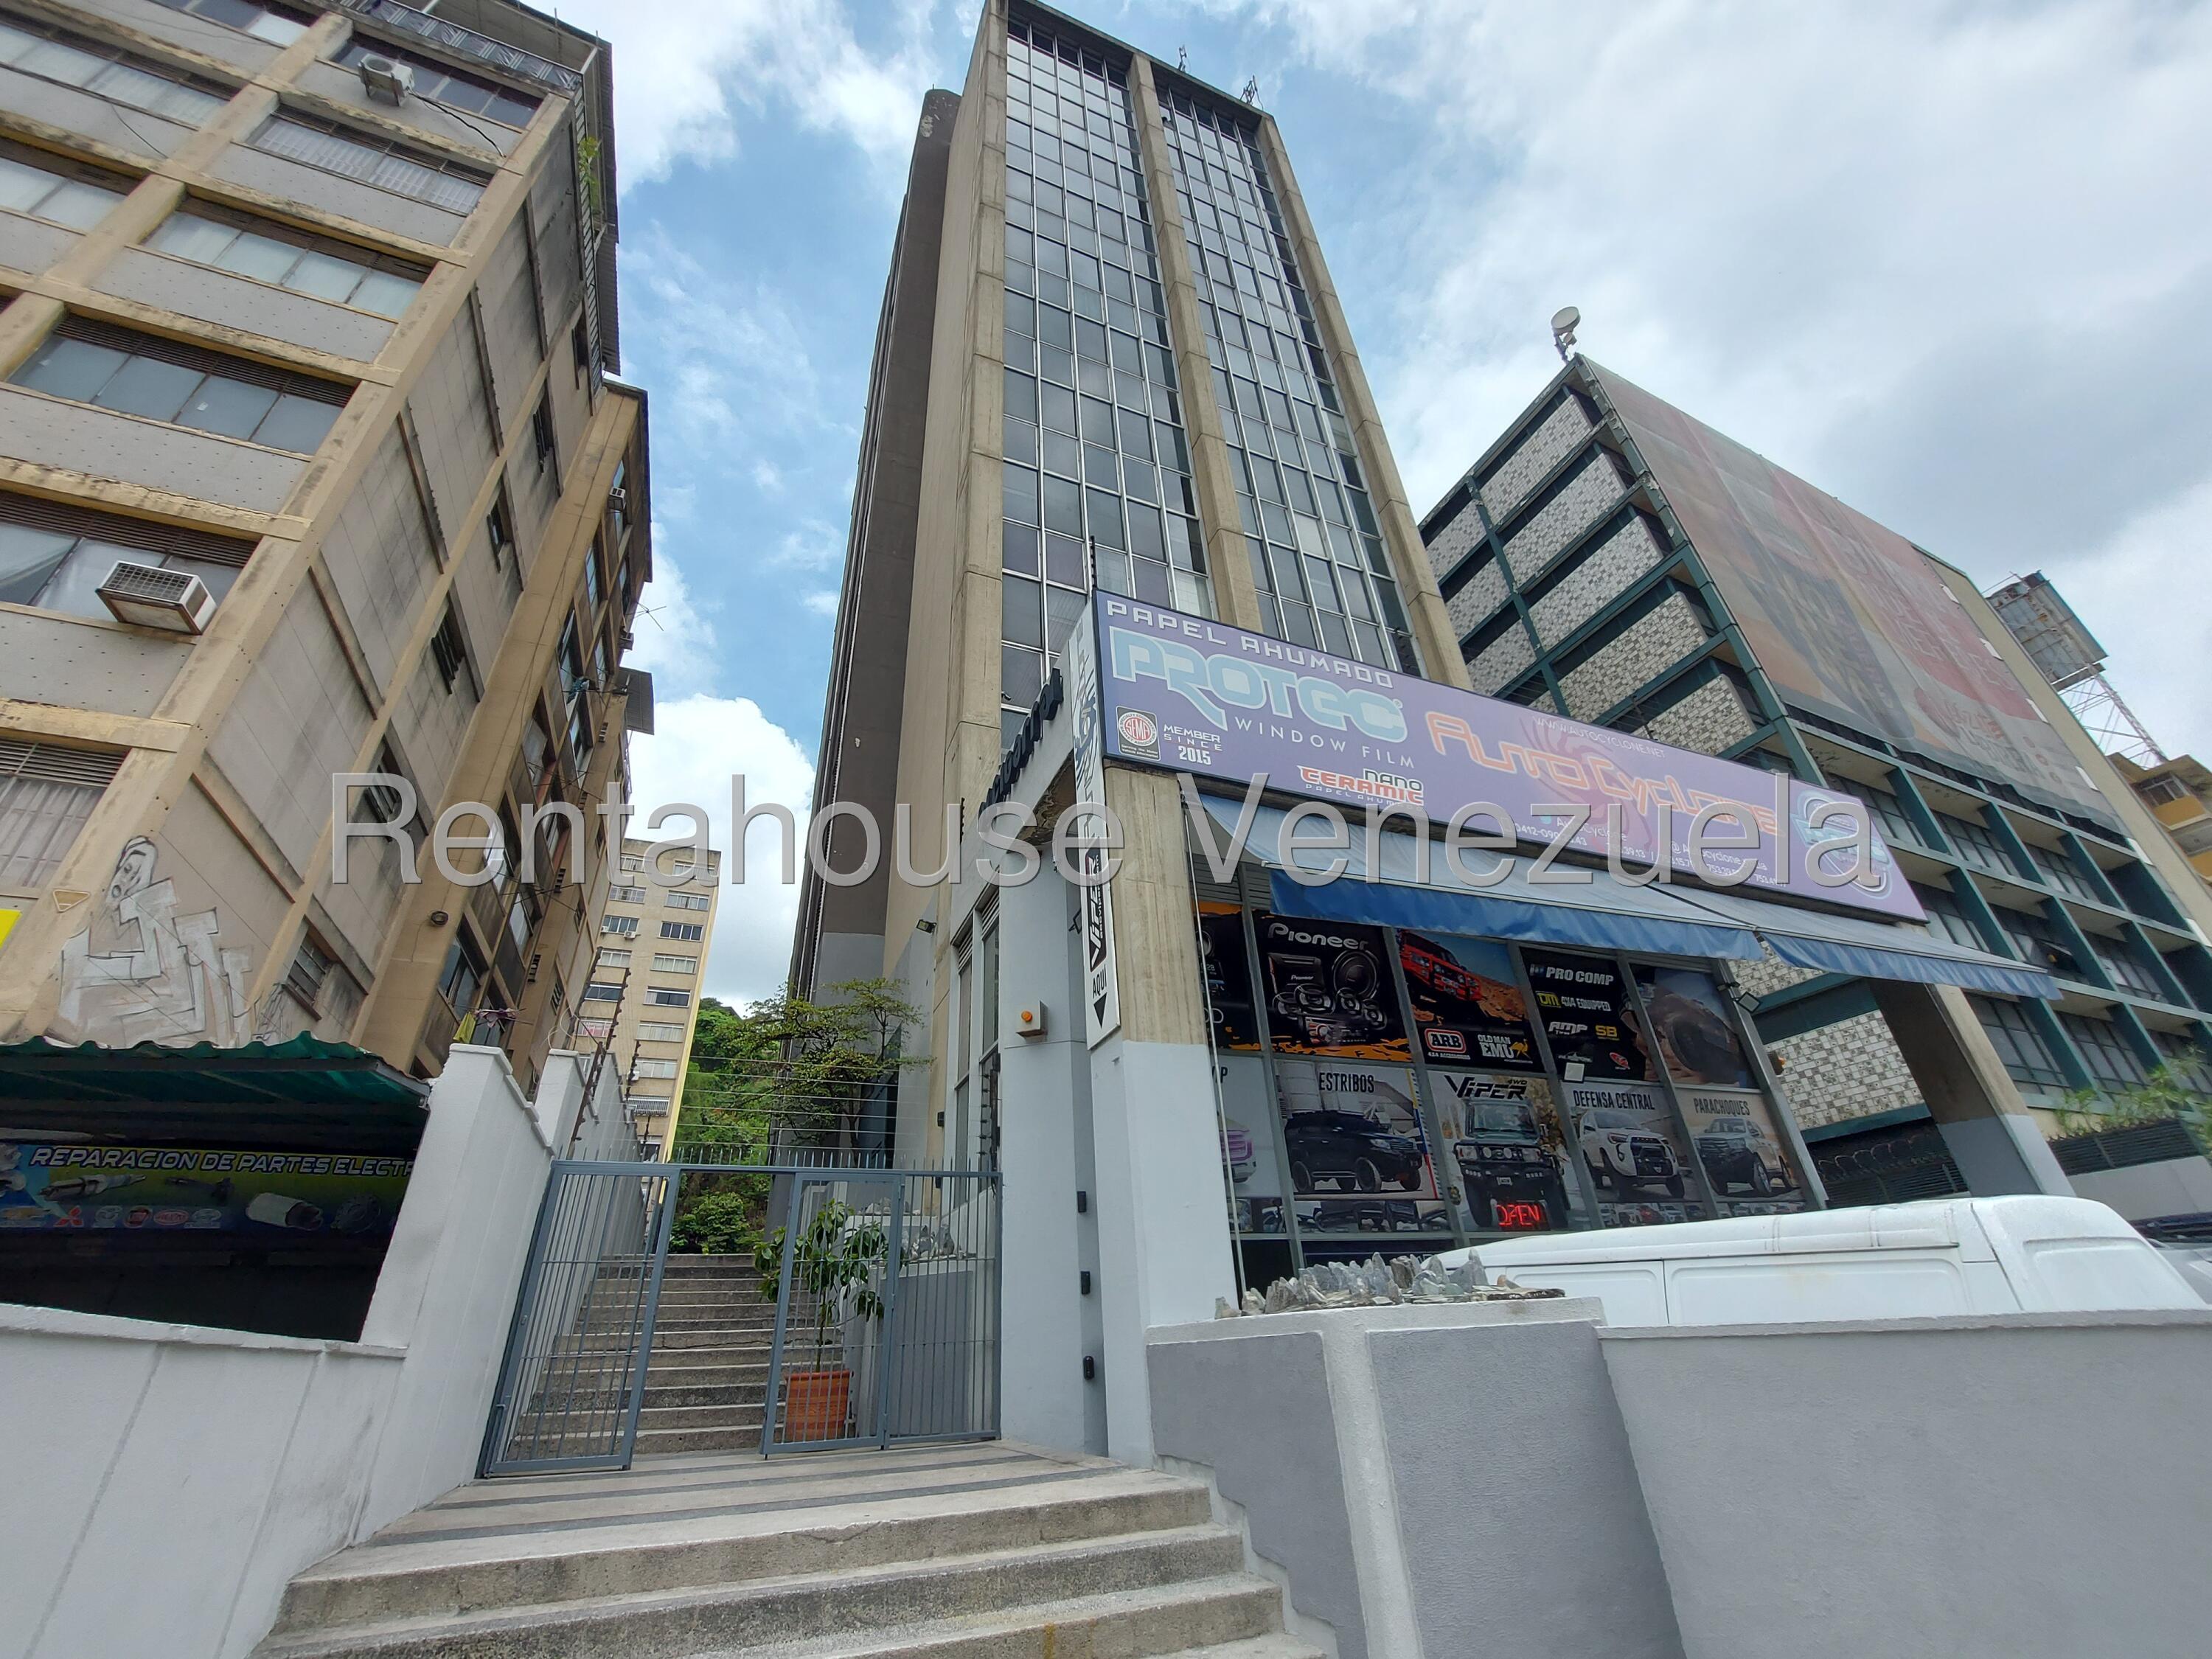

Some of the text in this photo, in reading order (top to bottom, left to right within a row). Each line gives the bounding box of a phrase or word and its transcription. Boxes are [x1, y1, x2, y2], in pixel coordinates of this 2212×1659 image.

[1107, 599, 1394, 689] PAPEL AHUMADO
[1108, 626, 1408, 742] PROTEC
[1125, 719, 1150, 740] SEMA
[1164, 723, 1221, 743] MEMBER
[1164, 734, 1223, 751] SINCE
[1236, 716, 1415, 768] WINDOW FILM
[1178, 745, 1212, 765] 2015
[1296, 765, 1424, 805] CERAMIC
[1306, 783, 1352, 798] PAPEL
[1268, 922, 1369, 951] Pioneer
[1545, 966, 1615, 986] PRO COMP
[1431, 1033, 1462, 1048] ARB
[1478, 1034, 1511, 1045] OLD MAN
[1480, 1042, 1514, 1059] EMU
[1318, 1071, 1375, 1093] ESTRIBOS
[1573, 1089, 1655, 1111] DEFENSA CENTRAL
[1694, 1097, 1751, 1116] PARACHOQUES
[30, 1147, 199, 1170] REPARACION
[201, 1152, 234, 1172] DE
[237, 1153, 331, 1175] PARTES
[1496, 1203, 1541, 1228] OPEN
